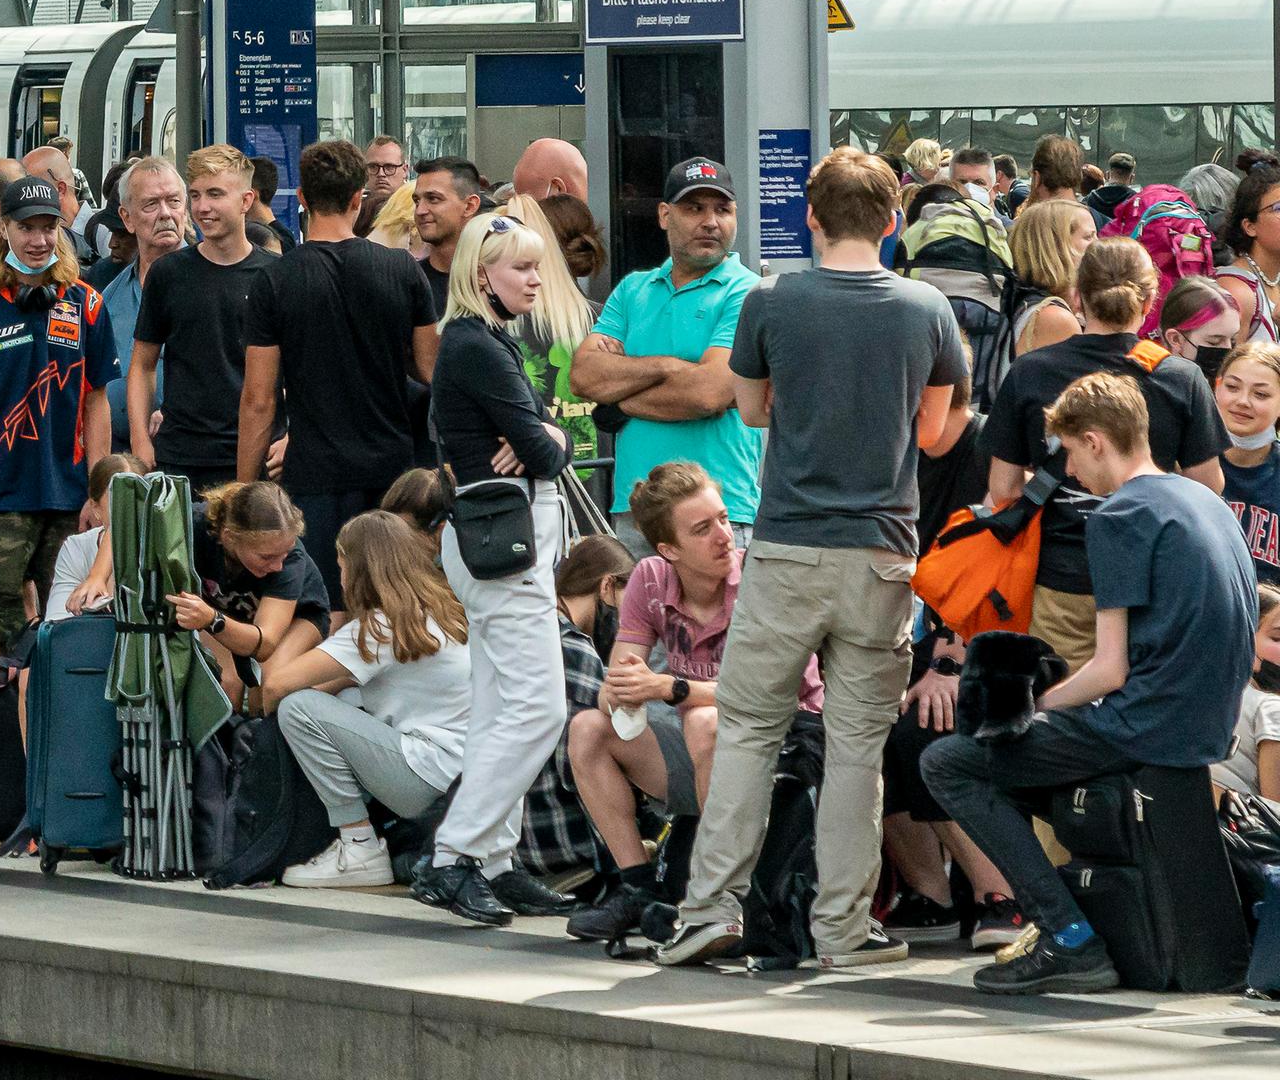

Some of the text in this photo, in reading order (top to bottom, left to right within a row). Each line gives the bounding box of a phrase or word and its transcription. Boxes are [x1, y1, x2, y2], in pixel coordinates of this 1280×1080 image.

[636, 13, 691, 28] please keep clear
[244, 30, 265, 46] 5-6
